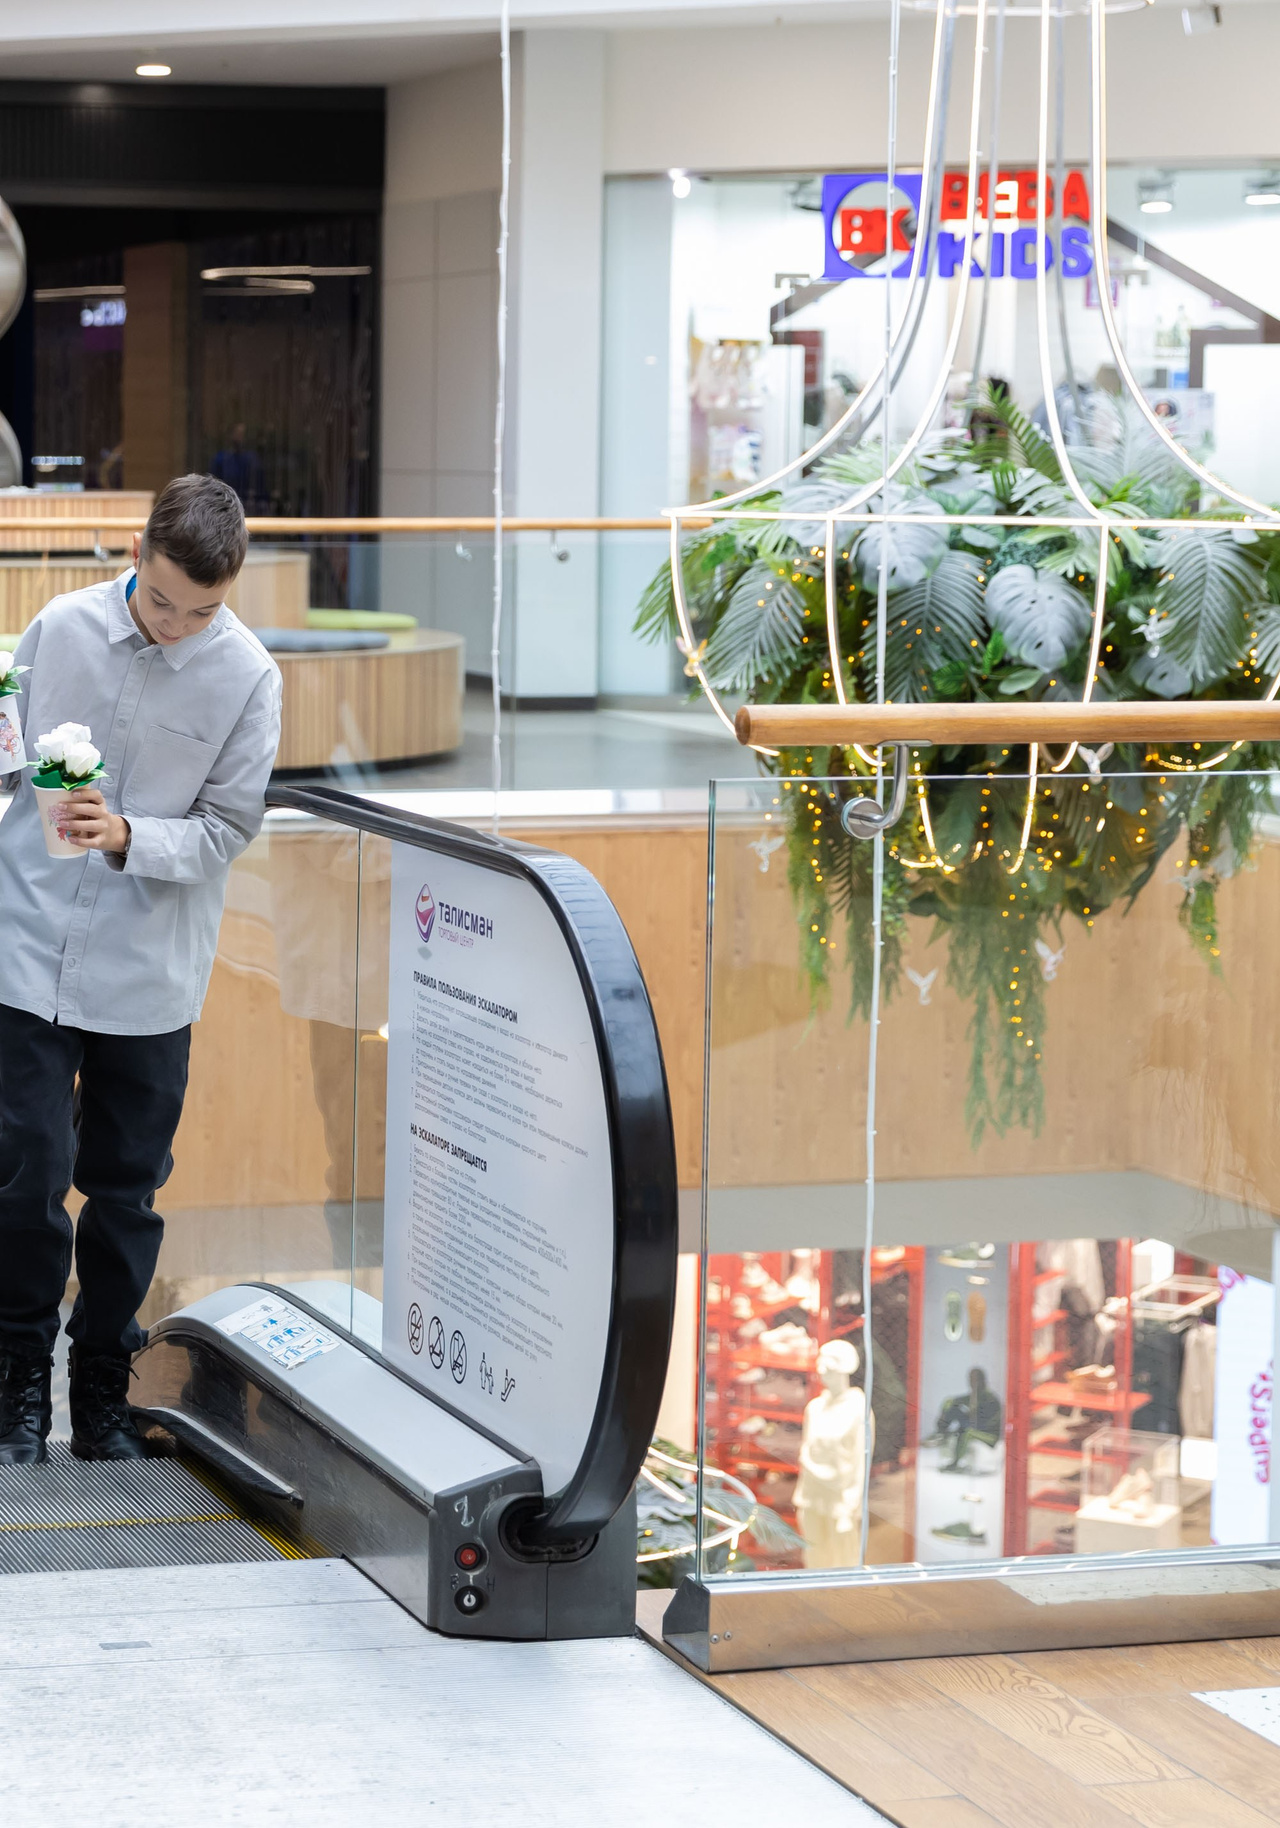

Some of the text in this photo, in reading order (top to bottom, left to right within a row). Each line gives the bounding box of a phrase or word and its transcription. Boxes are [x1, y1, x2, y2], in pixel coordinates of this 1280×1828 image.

[938, 227, 1093, 279] KIDS
[413, 970, 518, 1024] ПРАВИЛА ПОЛЬЗОВАНИЯ ЭСКАЛАТОРОМ
[410, 1122, 488, 1173] НА ЭСКАЛАТОРЕ ЗАПРЕЩАЕТСЯ
